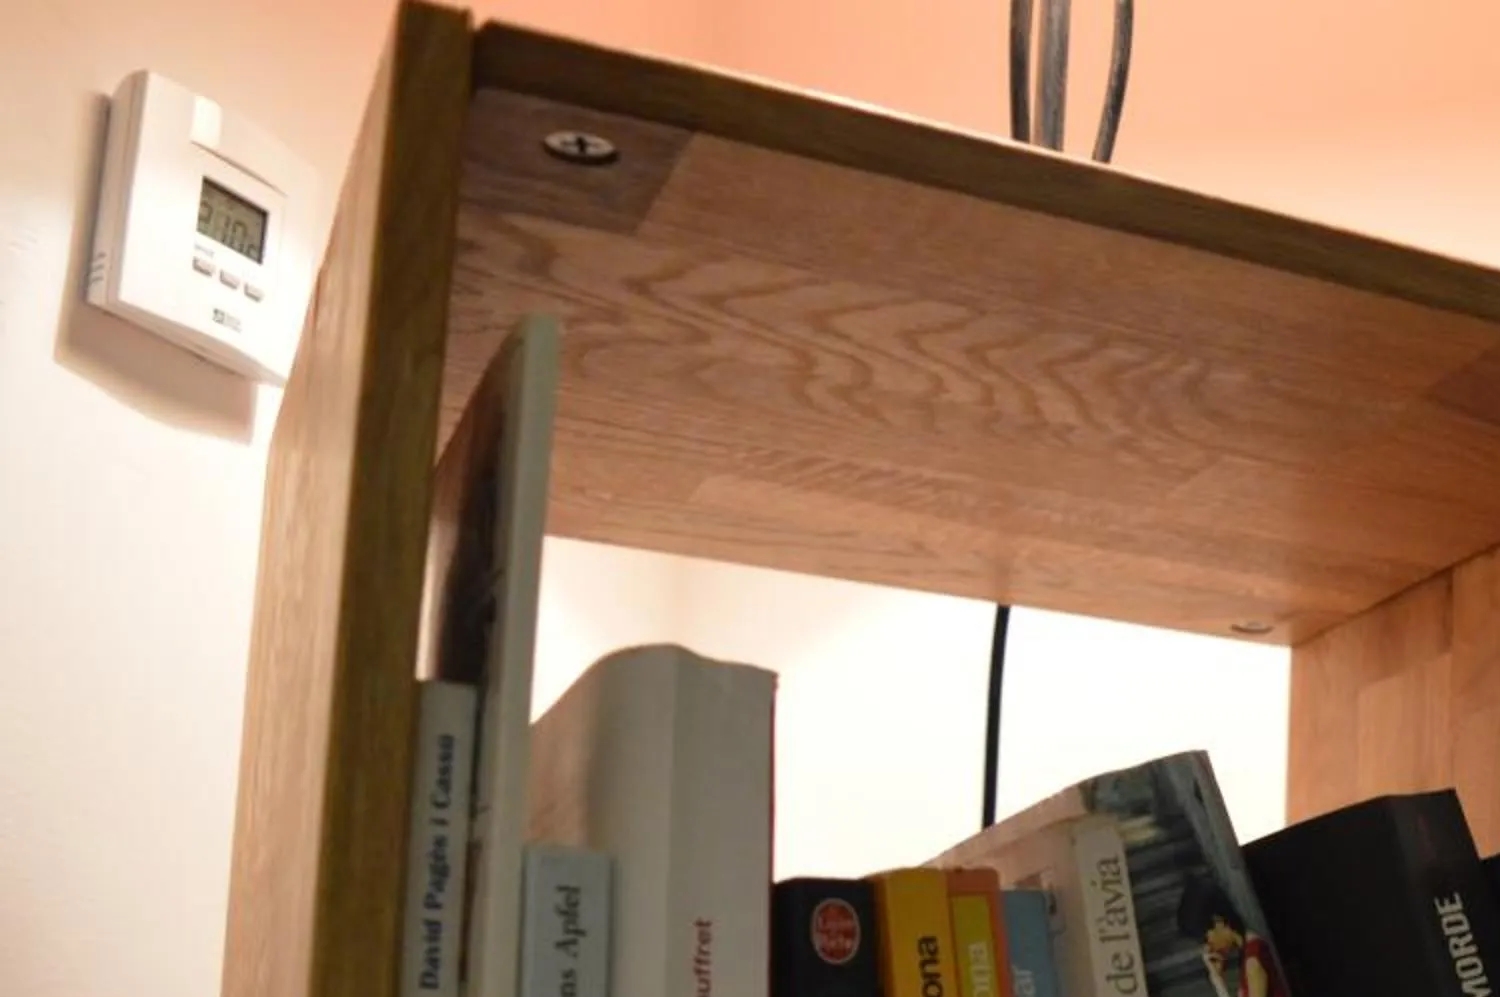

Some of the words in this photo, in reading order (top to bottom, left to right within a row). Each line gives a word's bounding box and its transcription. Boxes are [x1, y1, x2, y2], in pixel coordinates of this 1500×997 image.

[420, 918, 443, 991] David
[555, 885, 588, 958] Apfel
[1105, 954, 1139, 996] de
